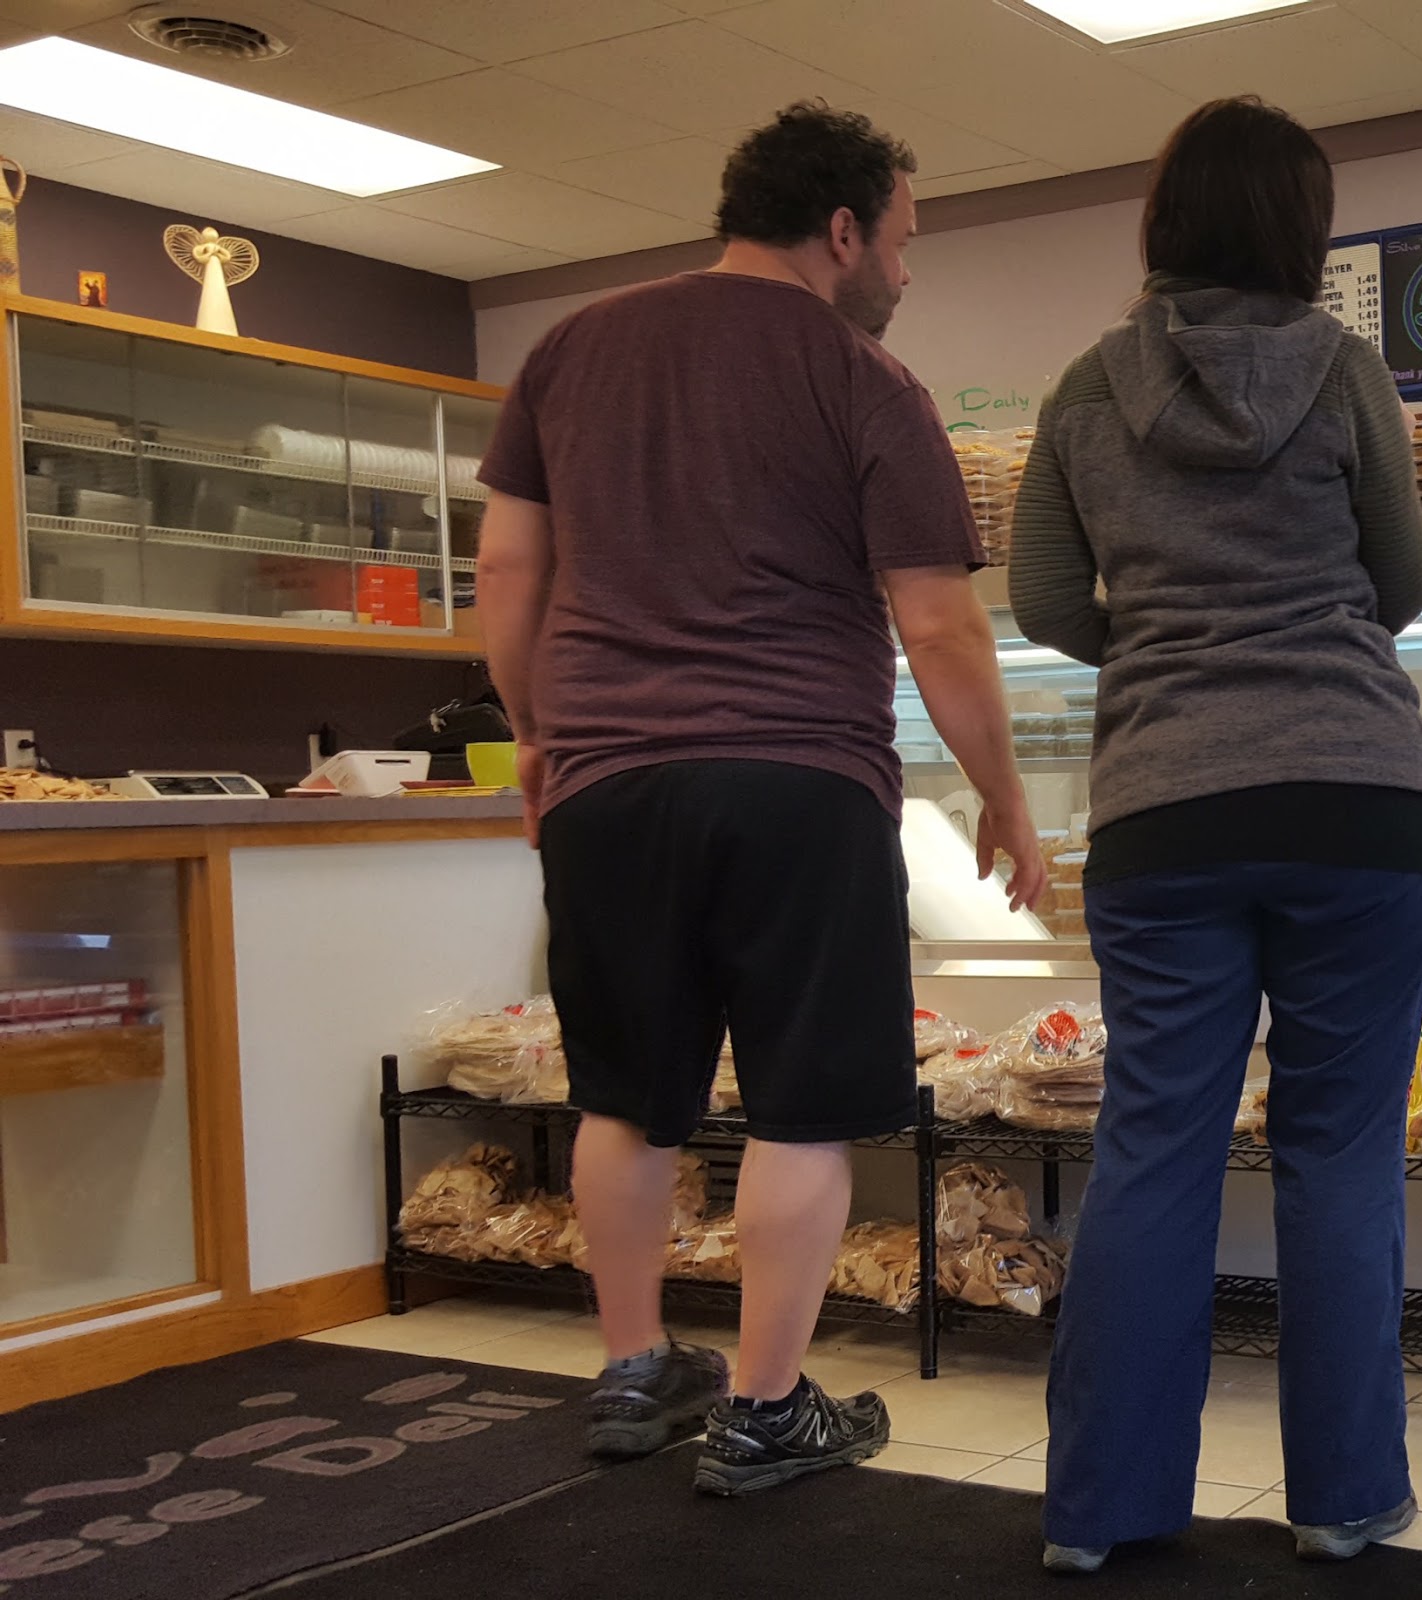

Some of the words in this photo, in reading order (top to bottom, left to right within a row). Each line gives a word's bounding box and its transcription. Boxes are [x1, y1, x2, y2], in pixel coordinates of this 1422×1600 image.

[1357, 274, 1377, 285] 1.49
[1357, 286, 1378, 297] 1.49
[1358, 298, 1378, 309] 1.49
[1358, 310, 1378, 321] 1.49
[1392, 369, 1414, 380] Thank
